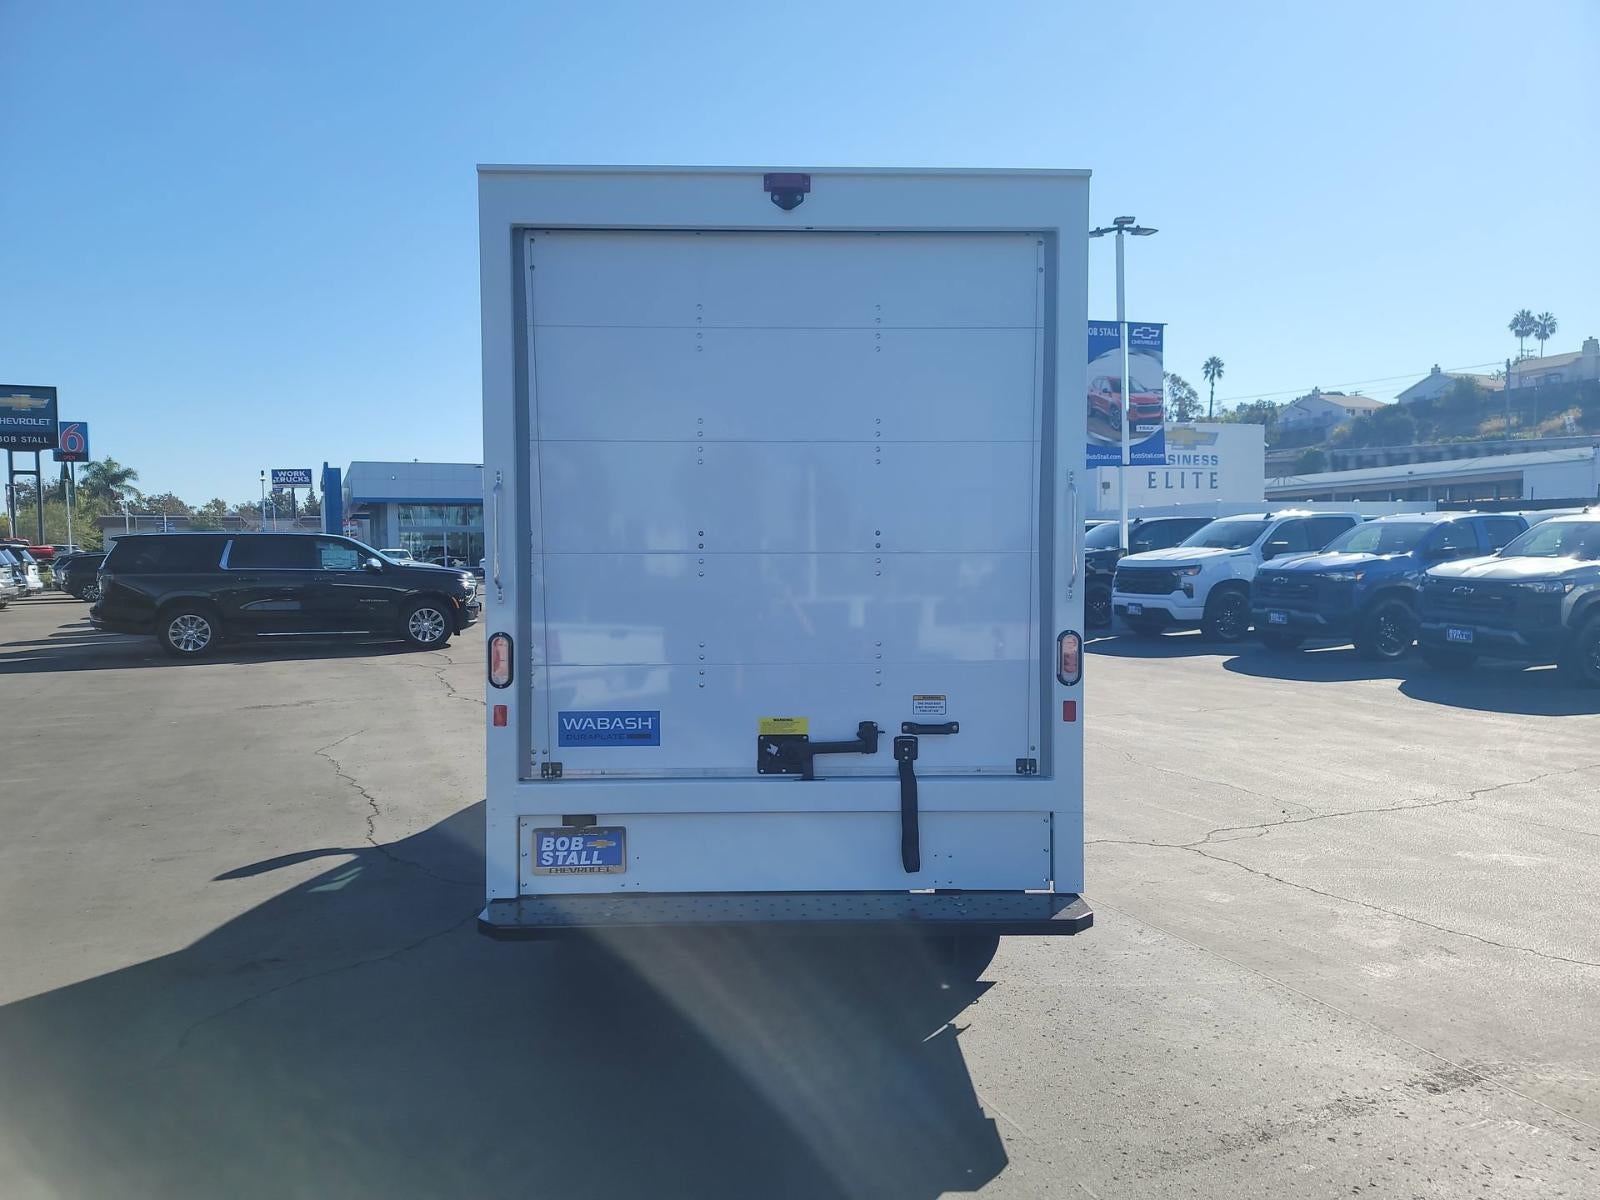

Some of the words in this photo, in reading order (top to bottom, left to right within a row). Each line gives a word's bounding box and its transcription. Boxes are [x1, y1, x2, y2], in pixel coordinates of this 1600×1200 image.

[1088, 327, 1098, 336] OB
[1099, 327, 1119, 337] STALL
[0, 417, 51, 426] HEVROLET
[20, 436, 49, 444] STALL
[60, 423, 85, 453] 6
[1168, 454, 1219, 466] SINESS
[1147, 471, 1219, 489] ELITE
[562, 717, 652, 730] WABASH
[541, 837, 584, 851] BOB
[541, 851, 603, 866] STALL
